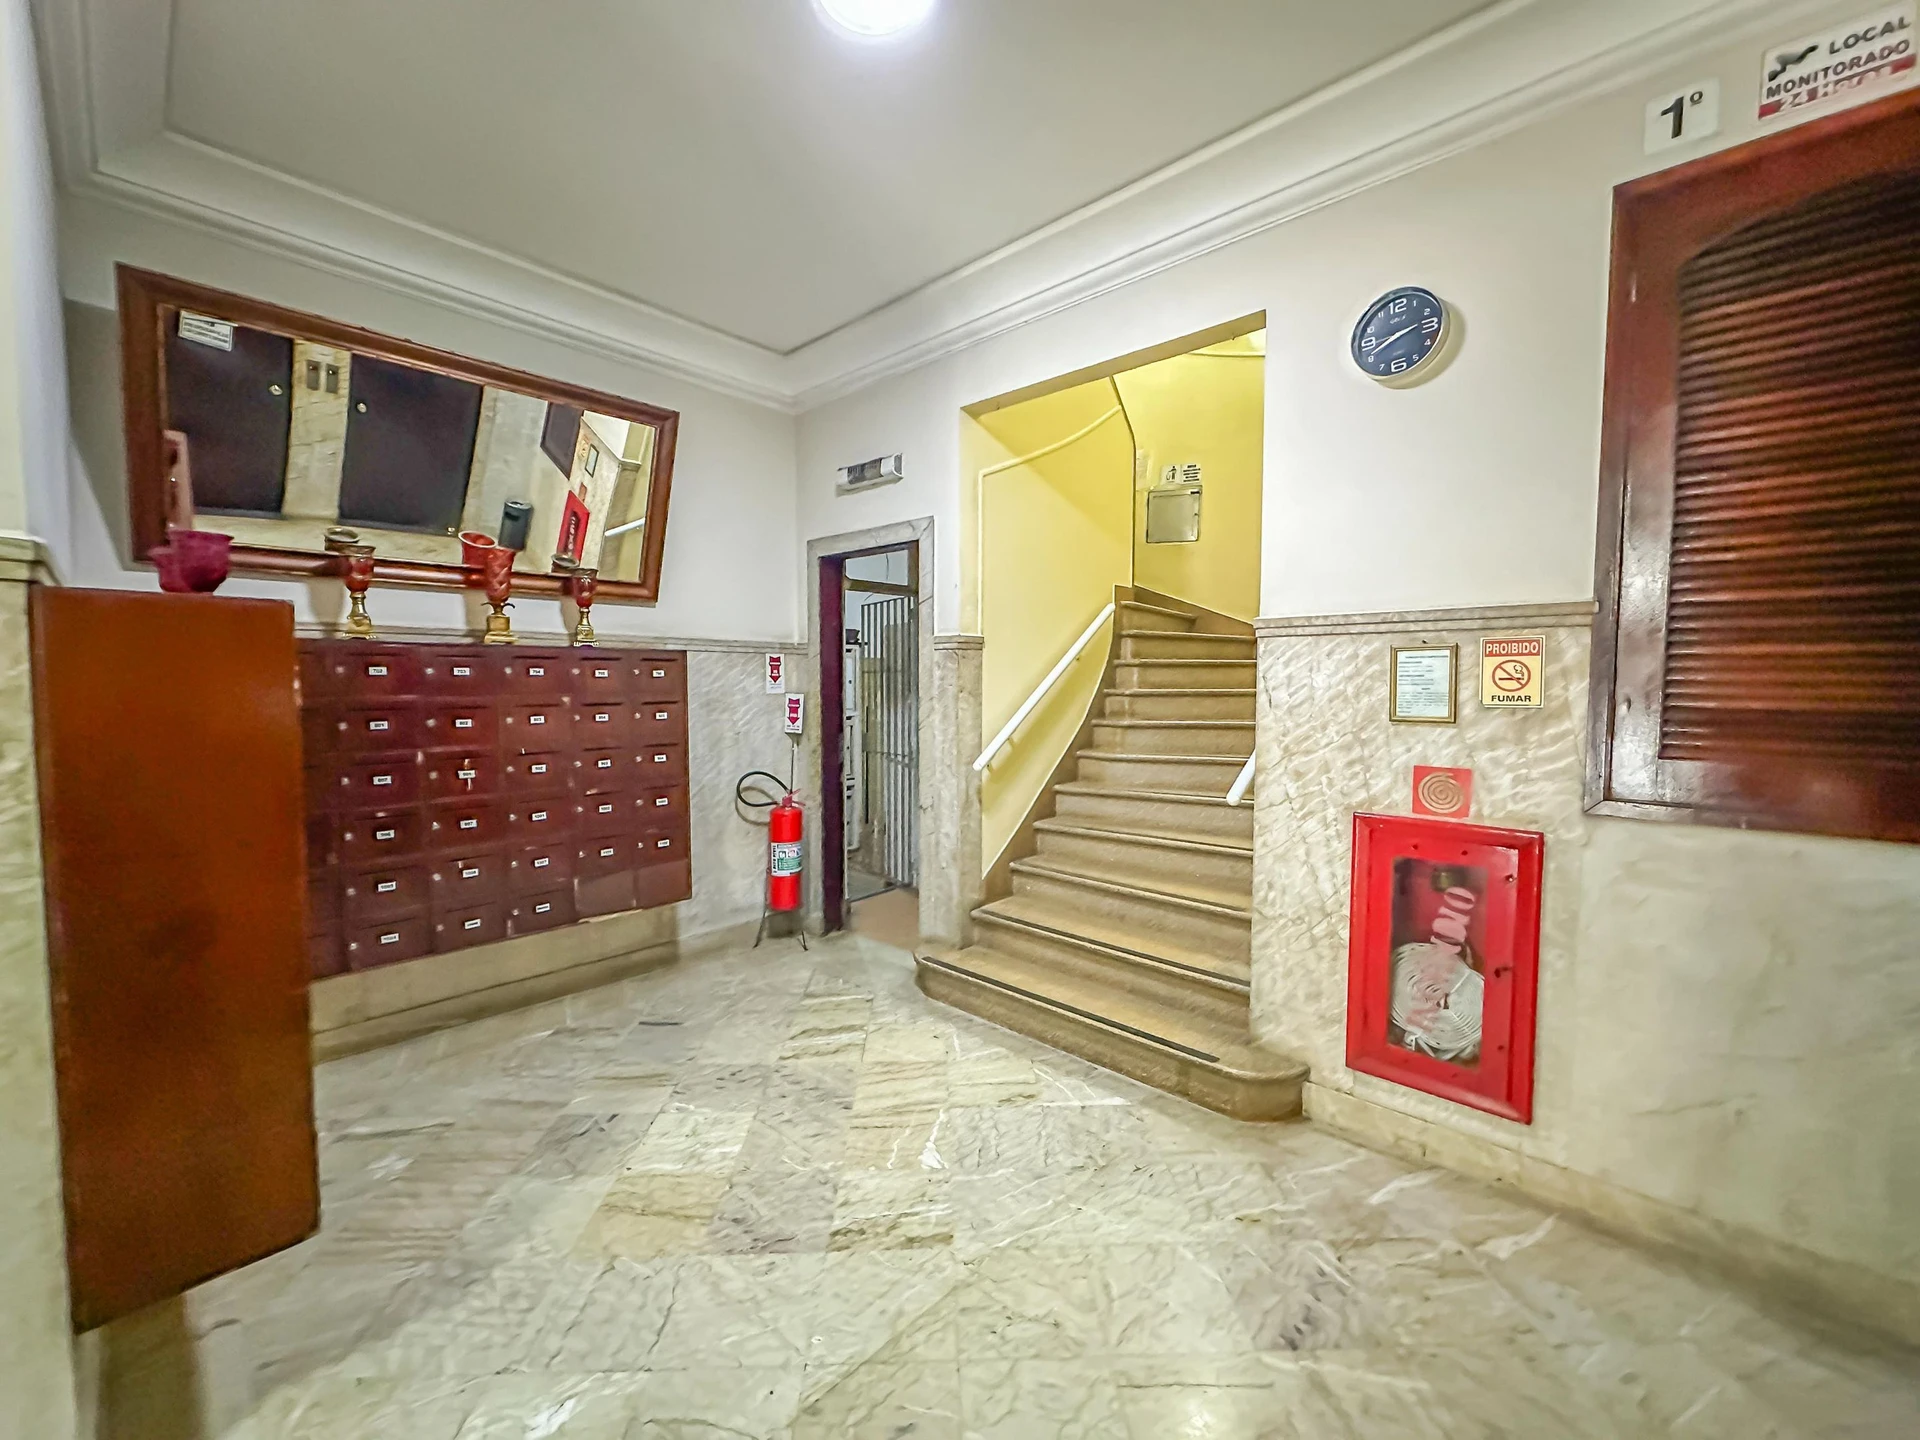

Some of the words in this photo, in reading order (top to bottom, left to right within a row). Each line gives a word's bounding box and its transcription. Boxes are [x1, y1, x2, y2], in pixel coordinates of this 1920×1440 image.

[1828, 16, 1911, 55] LOCAL
[1766, 39, 1910, 100] MONITORADO
[1389, 298, 1407, 314] 12
[1424, 308, 1431, 316] 2
[1367, 326, 1375, 334] 10
[1421, 317, 1439, 334] 3
[1361, 336, 1376, 351] 9
[1390, 357, 1407, 373] 6
[1412, 354, 1419, 362] 5
[1379, 363, 1386, 371] 7
[1486, 641, 1539, 655] PROIBIDO
